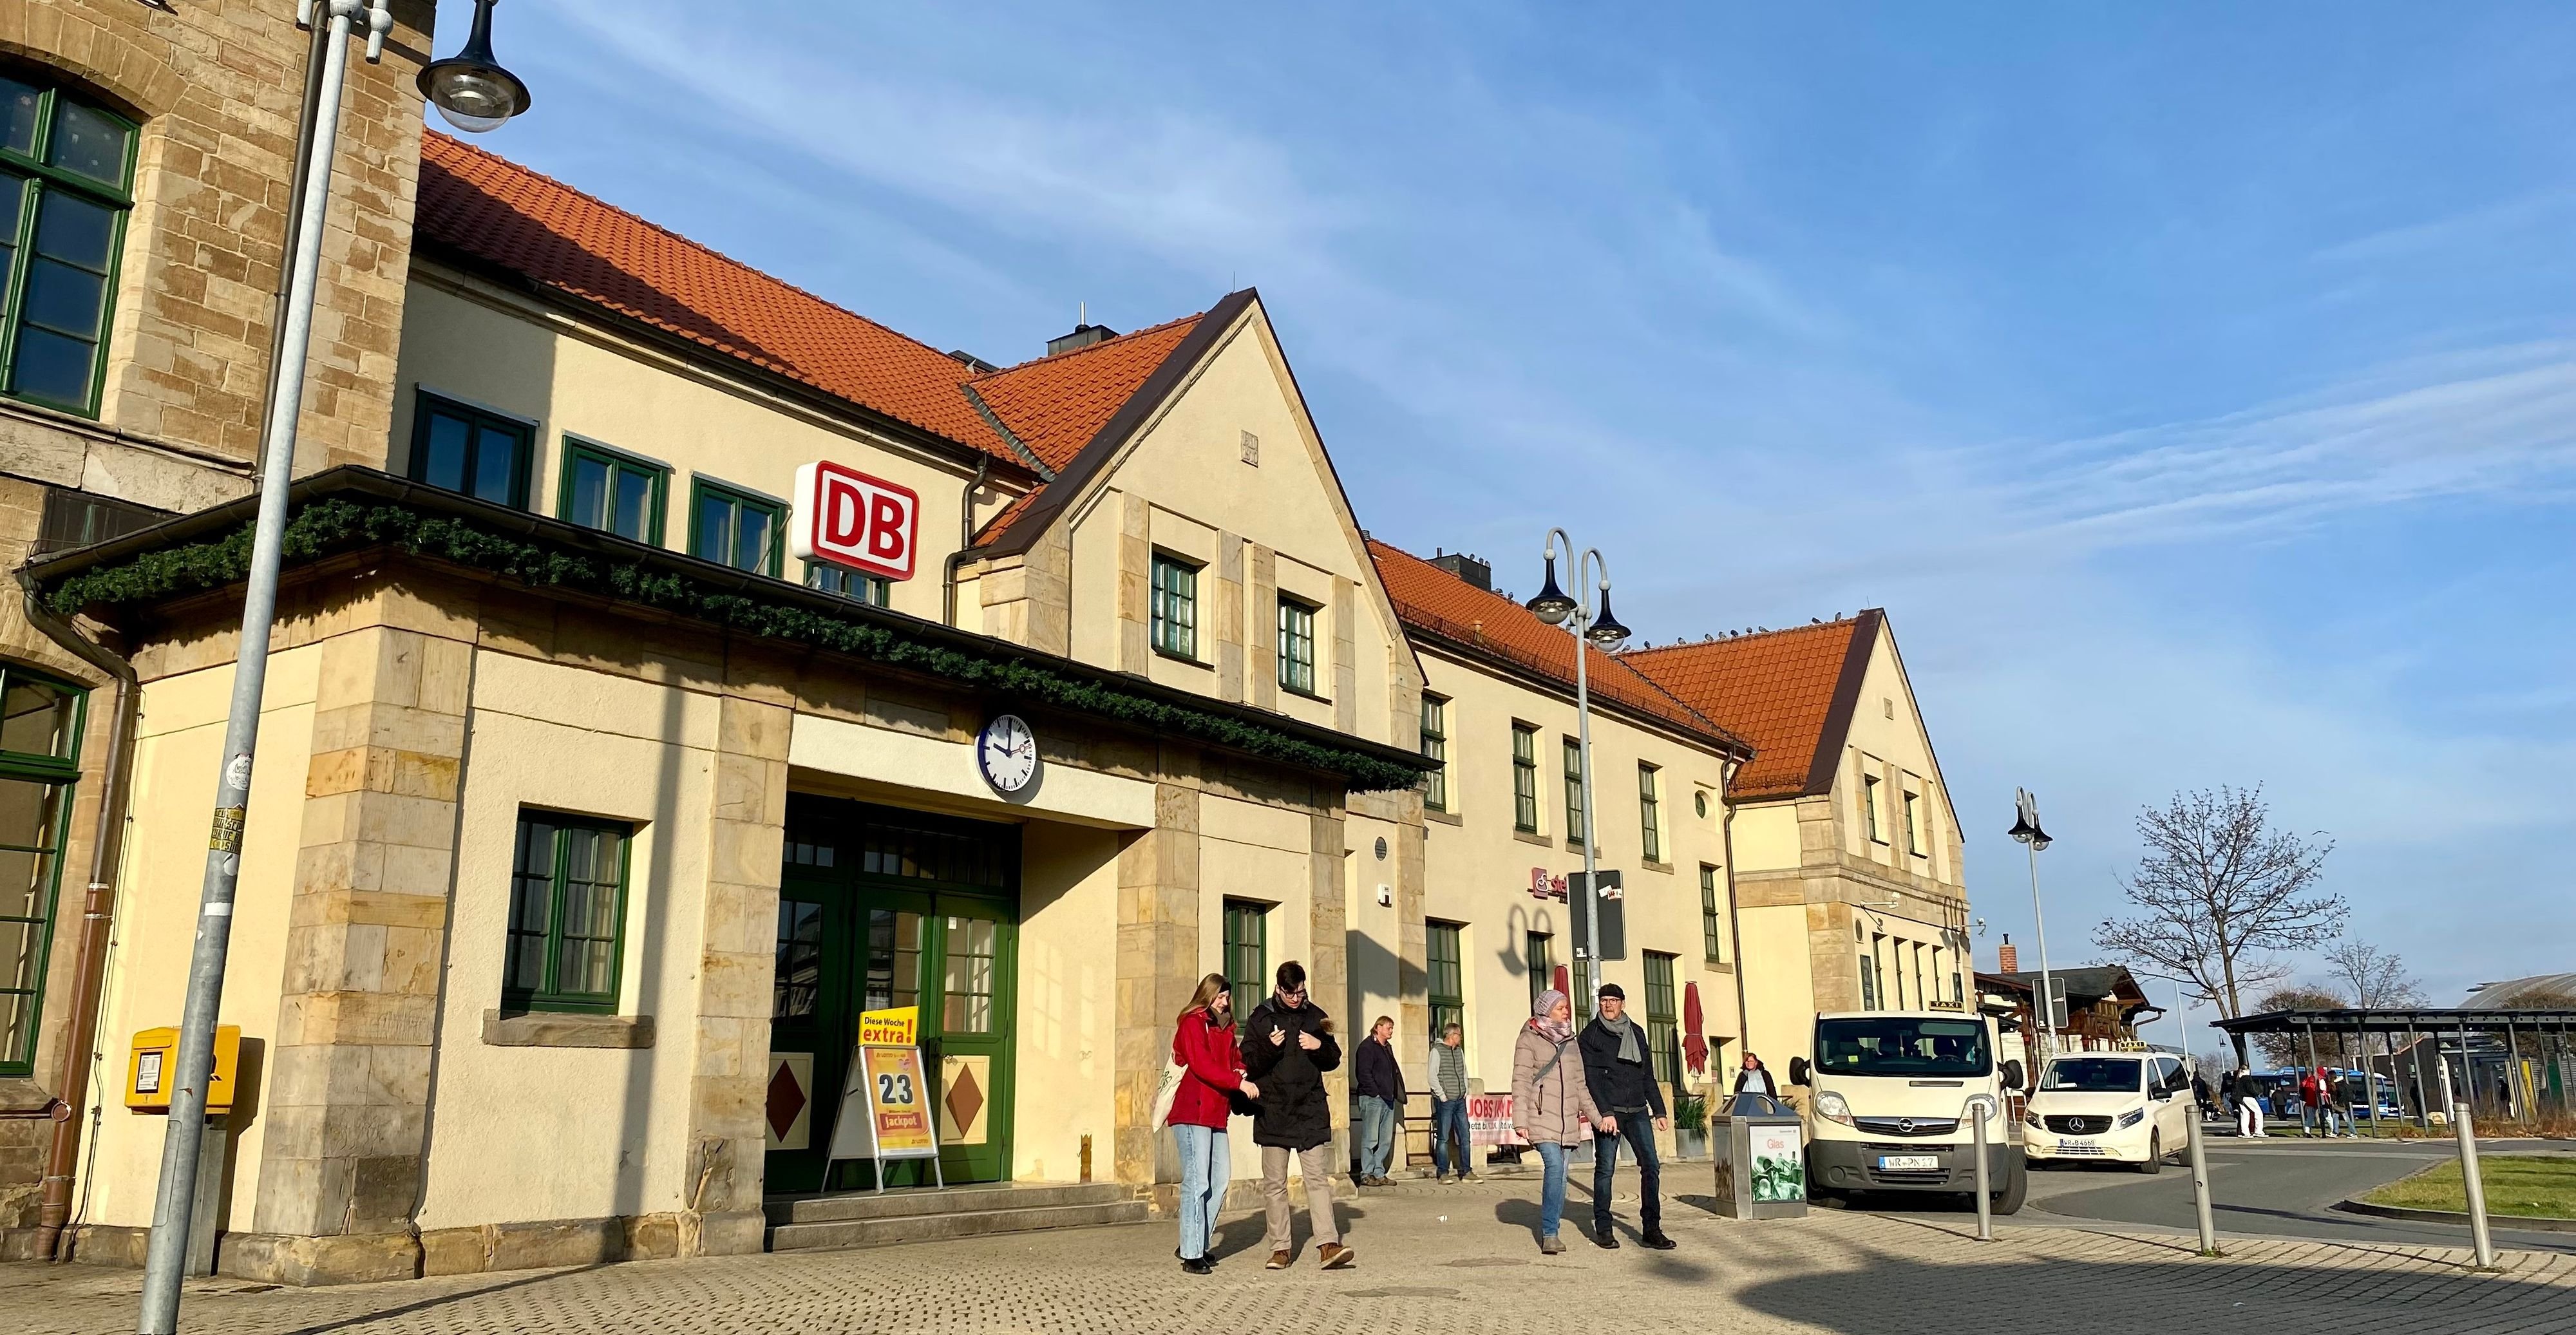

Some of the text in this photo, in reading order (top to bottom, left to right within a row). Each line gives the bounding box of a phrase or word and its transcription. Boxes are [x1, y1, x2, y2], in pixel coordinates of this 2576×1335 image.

[826, 478, 904, 560] DB
[864, 1019, 913, 1043] extra!
[865, 1017, 905, 1027] Diese Woche
[879, 1074, 913, 1104] 23
[1468, 1099, 1493, 1118] JOBS
[886, 1116, 917, 1129] Jackpot
[1767, 1139, 1784, 1149] Glas
